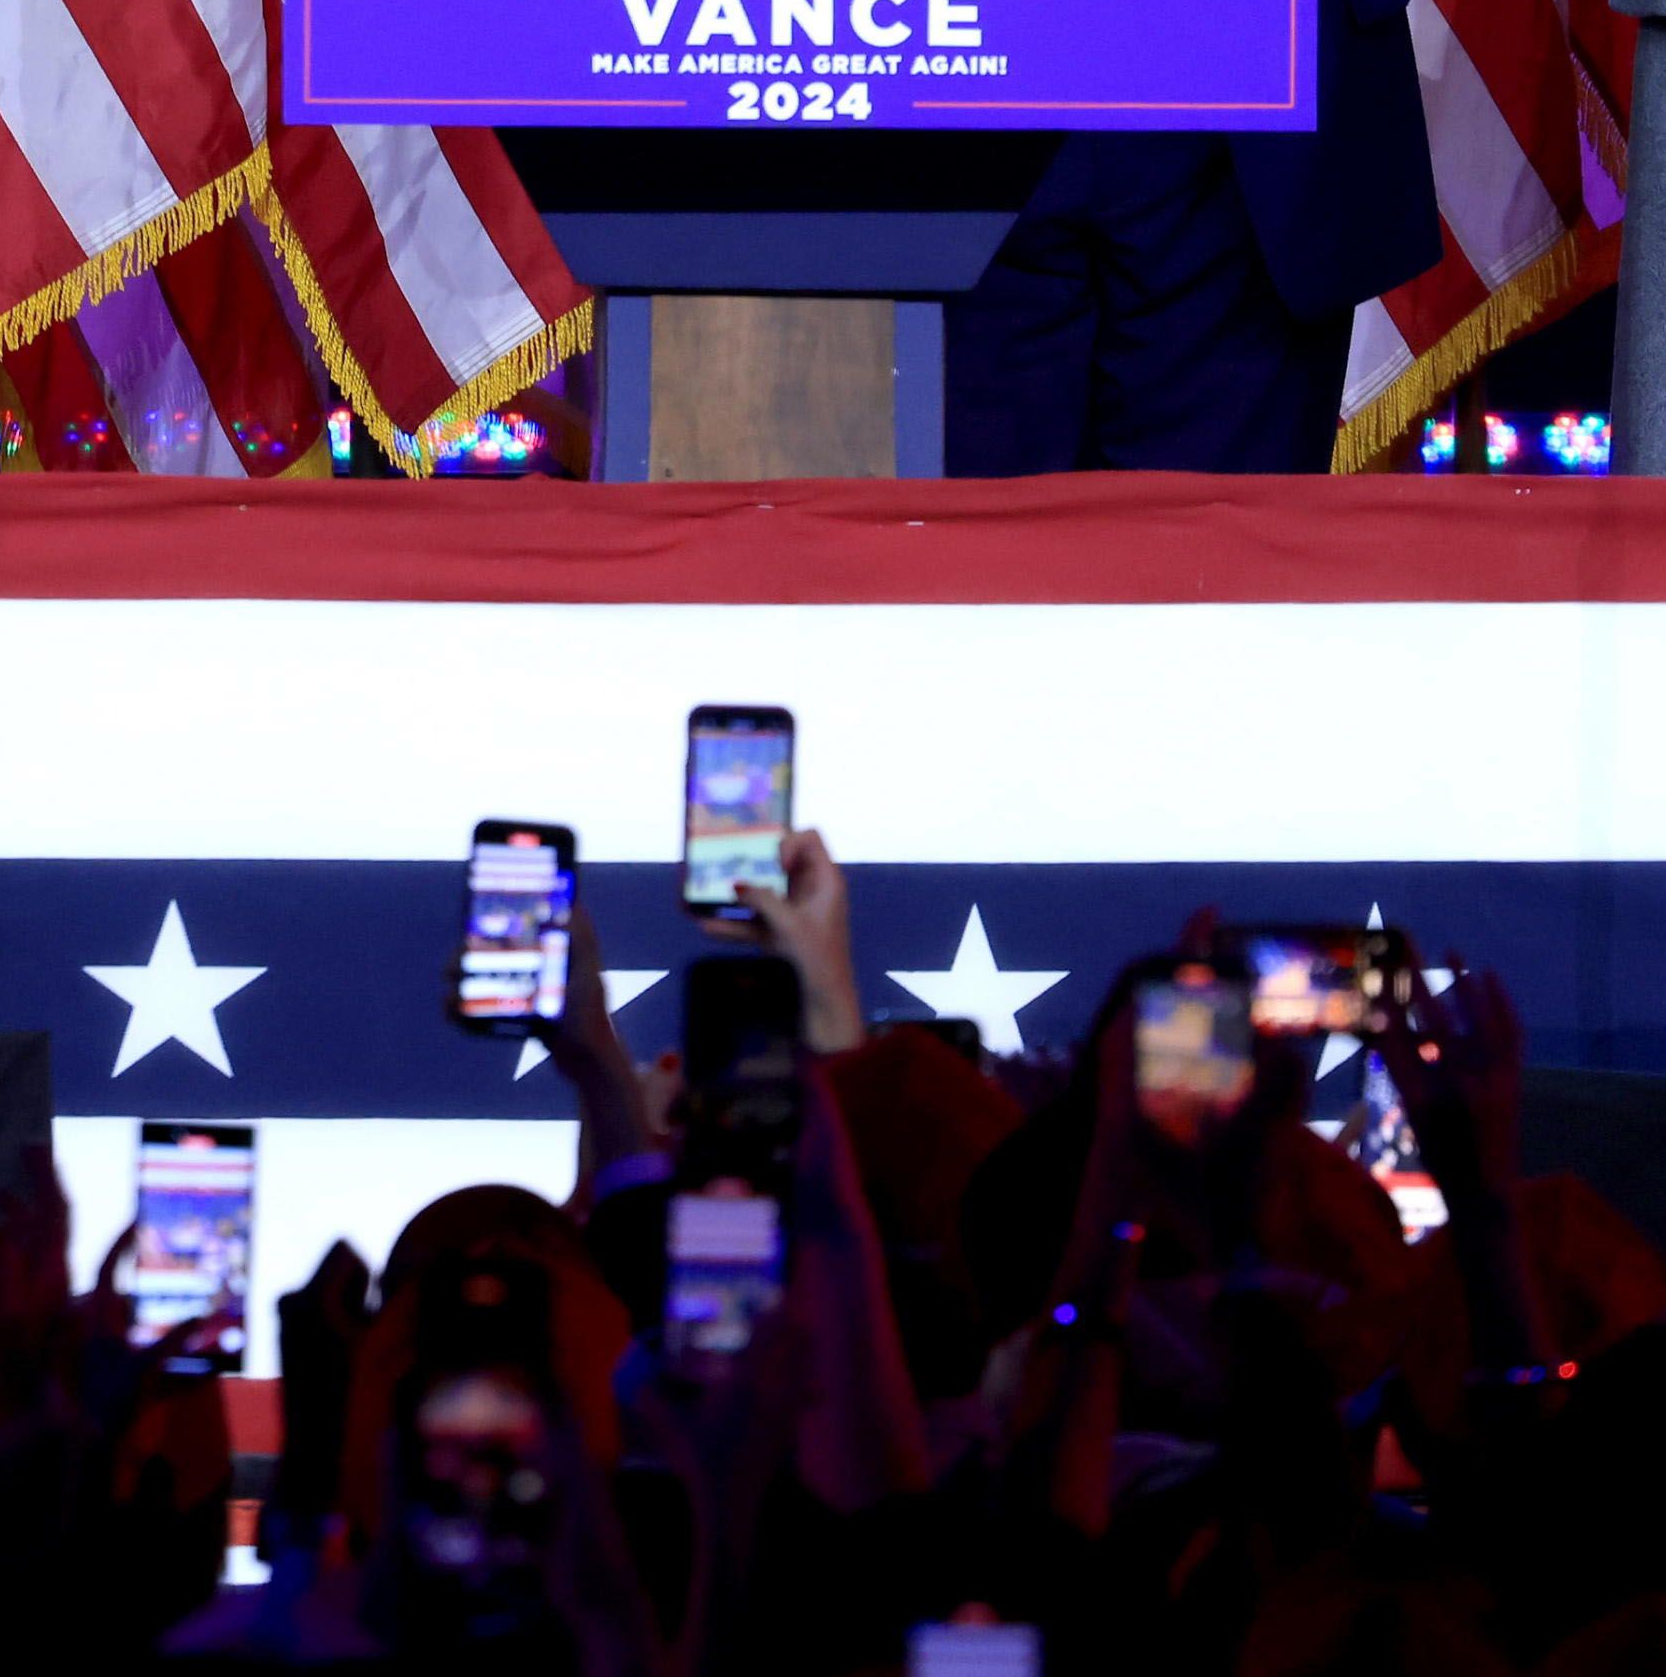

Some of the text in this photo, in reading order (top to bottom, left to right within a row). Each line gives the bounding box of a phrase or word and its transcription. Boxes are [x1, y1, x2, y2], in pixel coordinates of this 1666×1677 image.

[591, 52, 1008, 76] MAKE AMERICA GREAT AGAIN!
[726, 81, 872, 121] 2024
